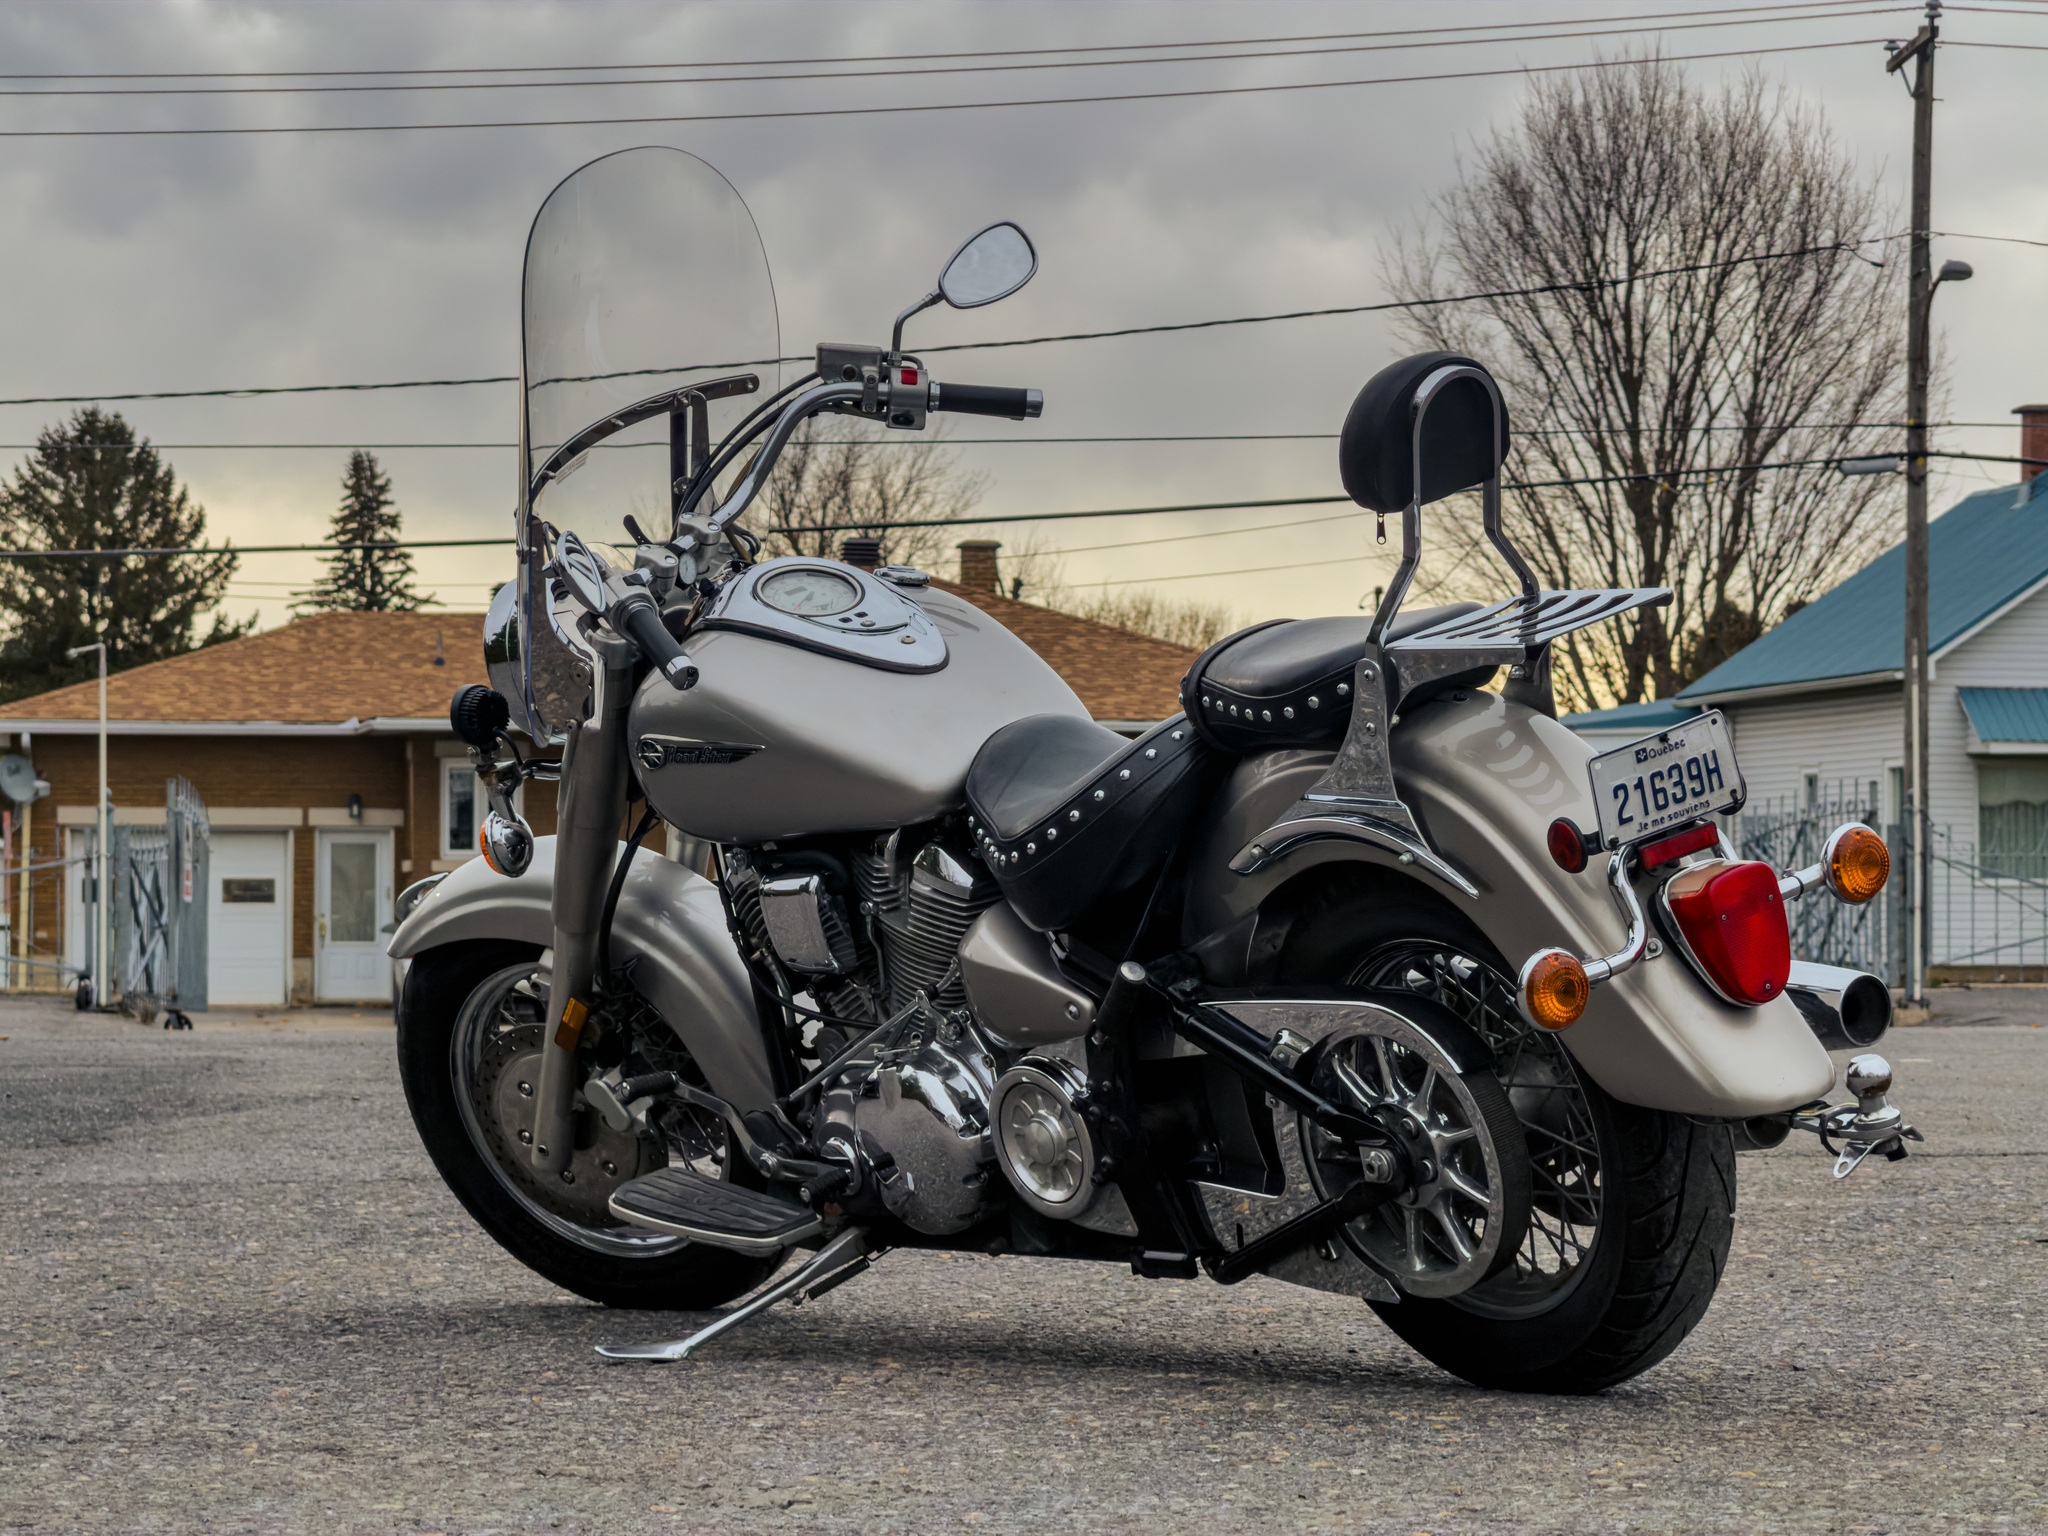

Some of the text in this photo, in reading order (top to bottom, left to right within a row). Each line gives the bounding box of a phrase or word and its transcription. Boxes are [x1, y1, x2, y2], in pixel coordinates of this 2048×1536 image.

[1612, 749, 1725, 826] 21639H
[1637, 799, 1711, 832] Je me souviens
